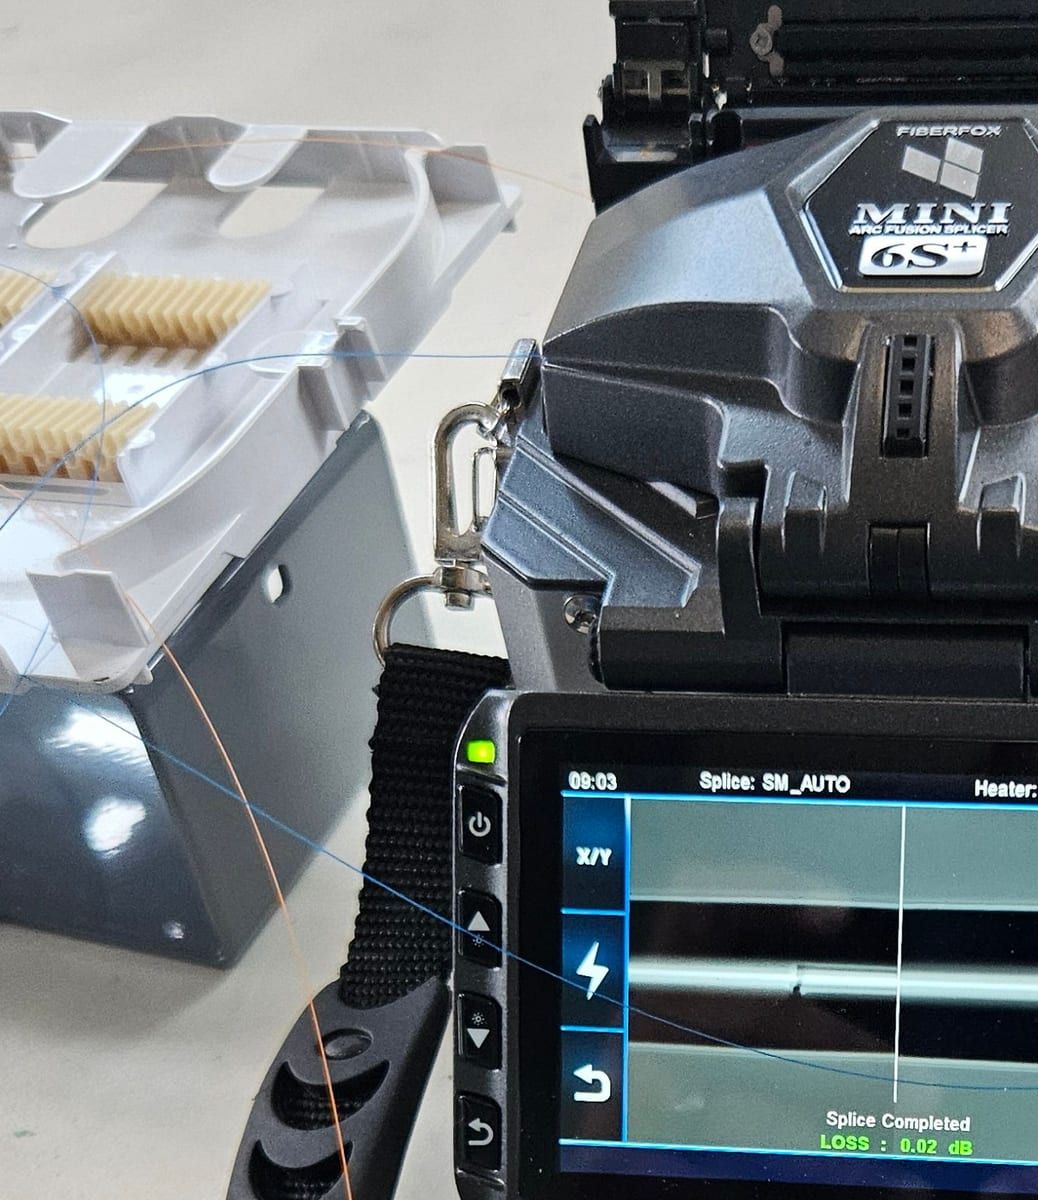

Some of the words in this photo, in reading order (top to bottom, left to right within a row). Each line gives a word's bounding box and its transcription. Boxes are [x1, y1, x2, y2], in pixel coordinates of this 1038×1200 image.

[896, 125, 1002, 137] FIBERFOX
[853, 202, 1013, 225] MINI
[849, 224, 882, 235] ARC
[884, 224, 942, 235] FUSION
[944, 224, 1009, 235] SPLICER
[870, 241, 977, 269] 6S+
[568, 771, 618, 790] 09:03
[699, 771, 755, 792] Splice:
[762, 773, 851, 795] SM_AUTO
[974, 779, 1038, 799] Heater:
[575, 846, 612, 866] X/Y
[826, 1111, 876, 1129] Splice
[881, 1113, 971, 1132] Completed
[820, 1134, 870, 1151] LOSS
[899, 1138, 937, 1154] 0.02
[948, 1139, 973, 1156] dB
